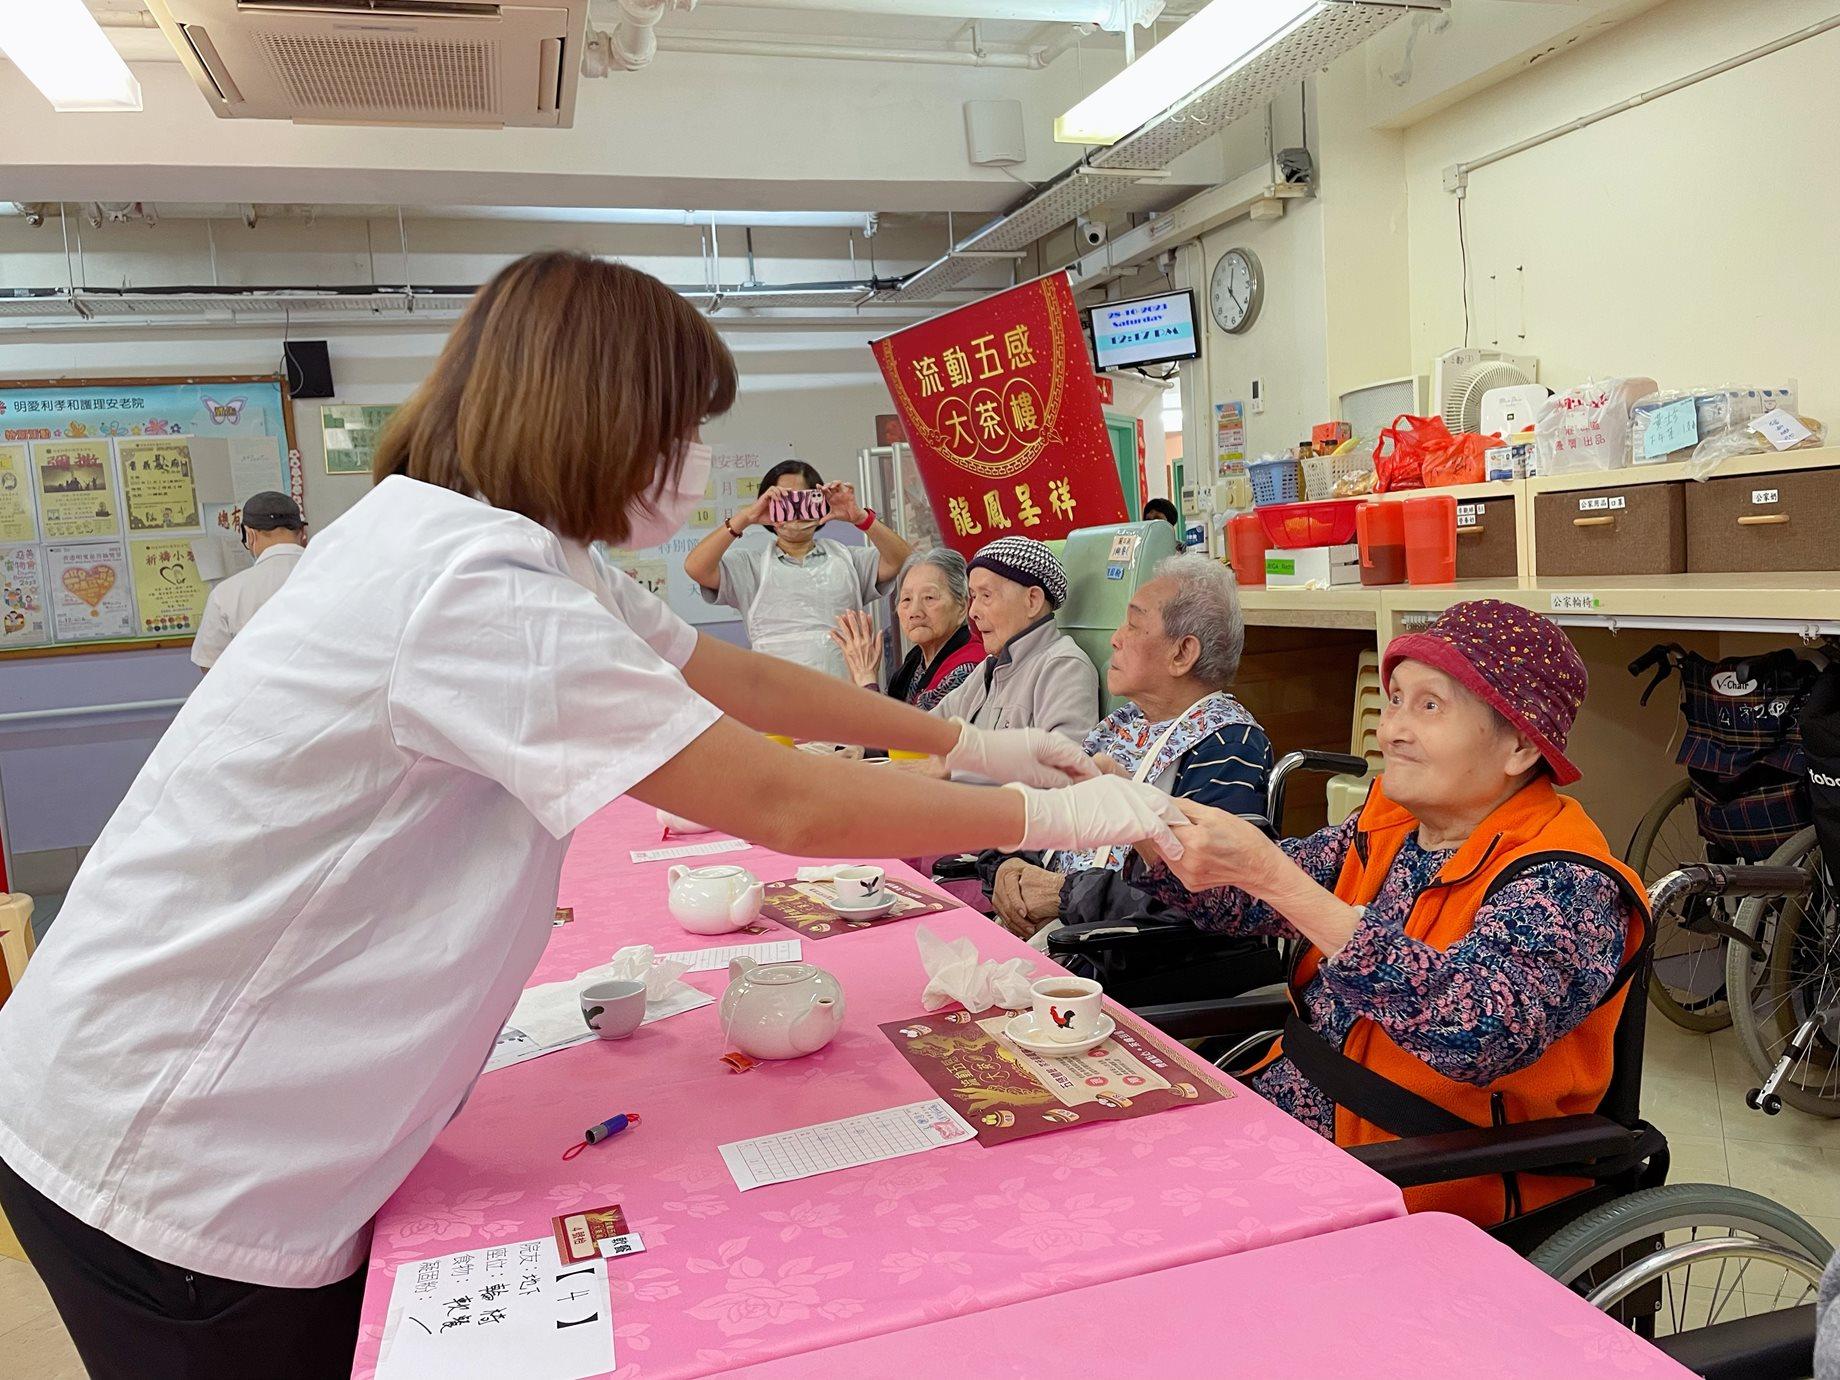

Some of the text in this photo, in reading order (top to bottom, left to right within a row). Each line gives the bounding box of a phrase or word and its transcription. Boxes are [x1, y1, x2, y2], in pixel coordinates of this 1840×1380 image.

[1112, 314, 1164, 328] Saturday
[1111, 328, 1179, 345] 12:17 PM
[912, 324, 1037, 397] 流動五感
[14, 398, 144, 412] 明愛利孝和護理安老院
[945, 391, 1040, 448] 大茶樓
[948, 477, 1078, 537] 龍鳳呈祥
[697, 510, 709, 521] 10
[1553, 596, 1592, 608] 公家輪椅
[1716, 675, 1750, 691] V-Chair
